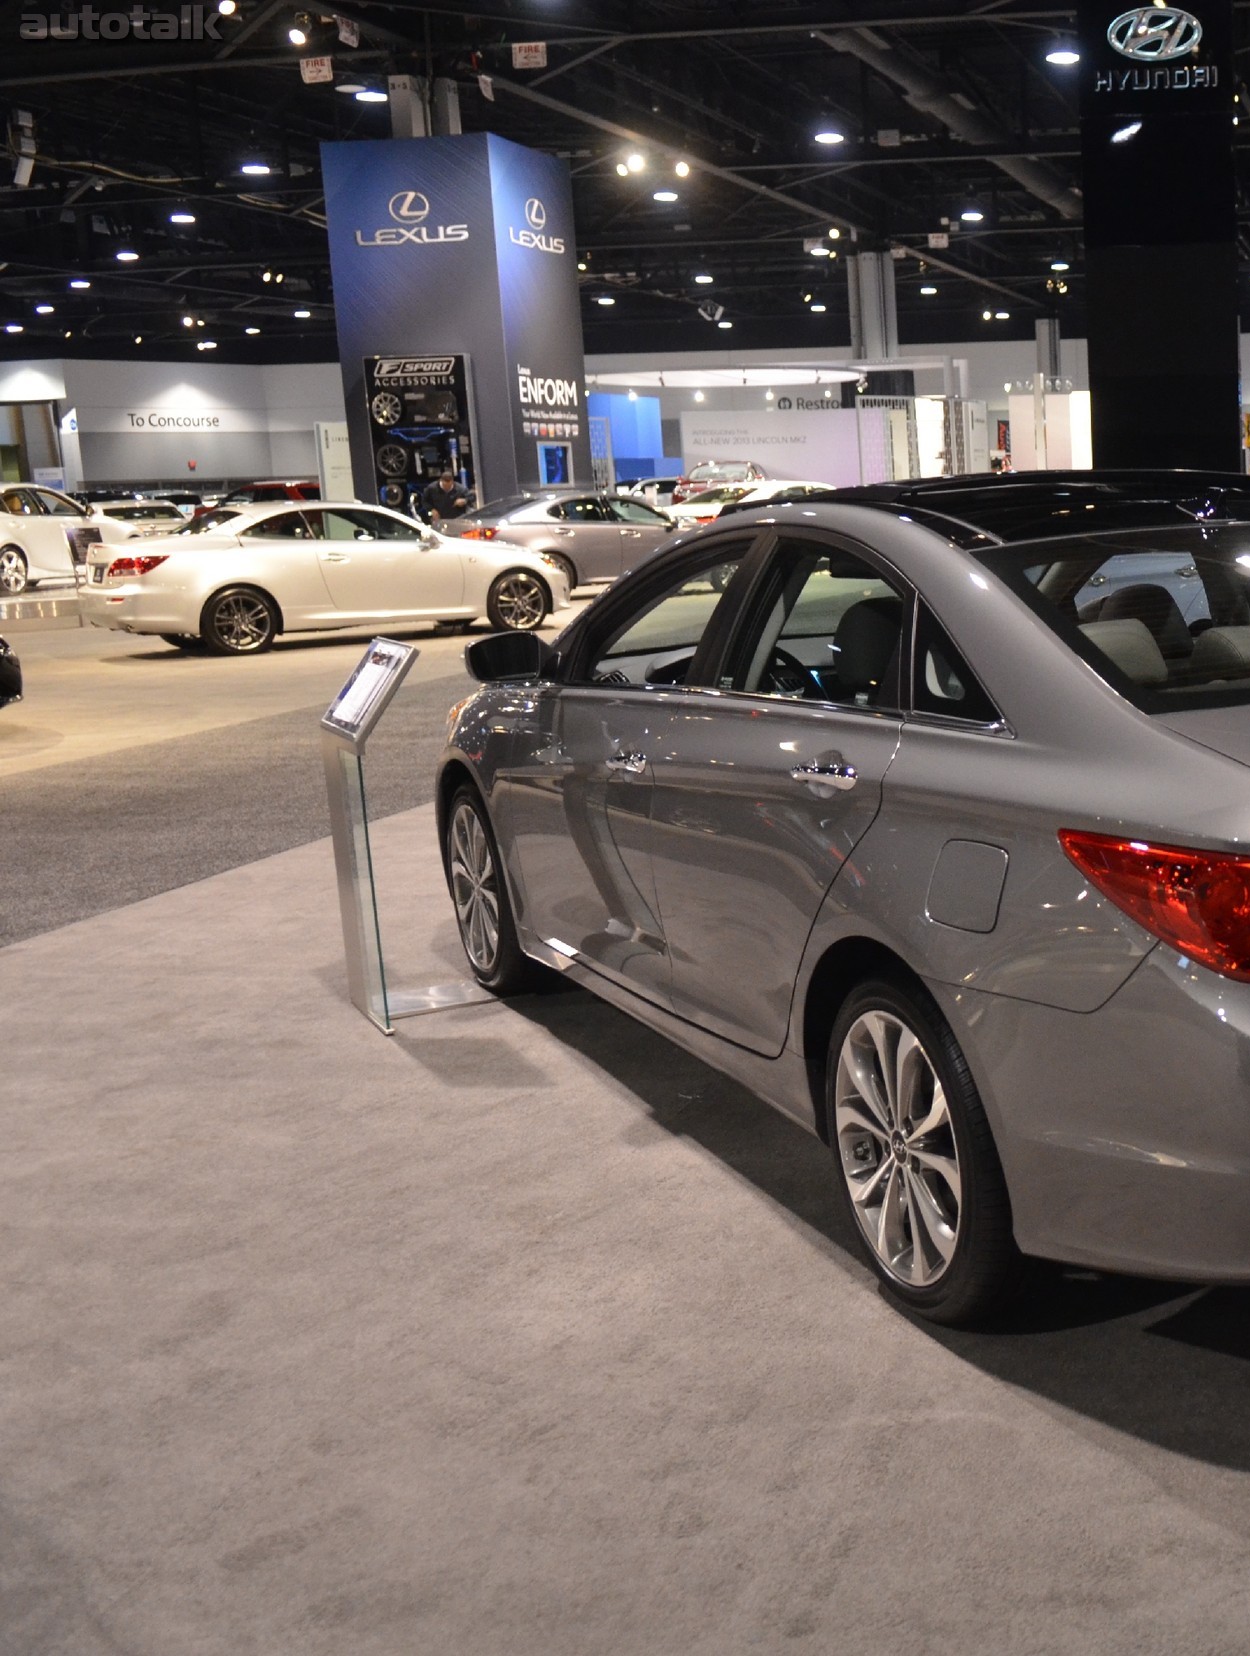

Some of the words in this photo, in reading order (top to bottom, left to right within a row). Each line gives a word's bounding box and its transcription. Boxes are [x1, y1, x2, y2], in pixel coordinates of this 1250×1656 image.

[518, 45, 540, 54] FIRE
[305, 58, 325, 68] FIRE
[1095, 66, 1218, 92] HYUNDAI
[356, 224, 469, 246] LEXUS
[509, 226, 565, 254] LEXUS
[380, 362, 401, 374] F
[403, 361, 450, 372] SPORT
[374, 375, 455, 386] ACCESSORIES
[518, 375, 578, 407] ENFORM
[796, 397, 842, 410] Restro
[127, 413, 145, 427] To
[148, 412, 220, 427] Concourse
